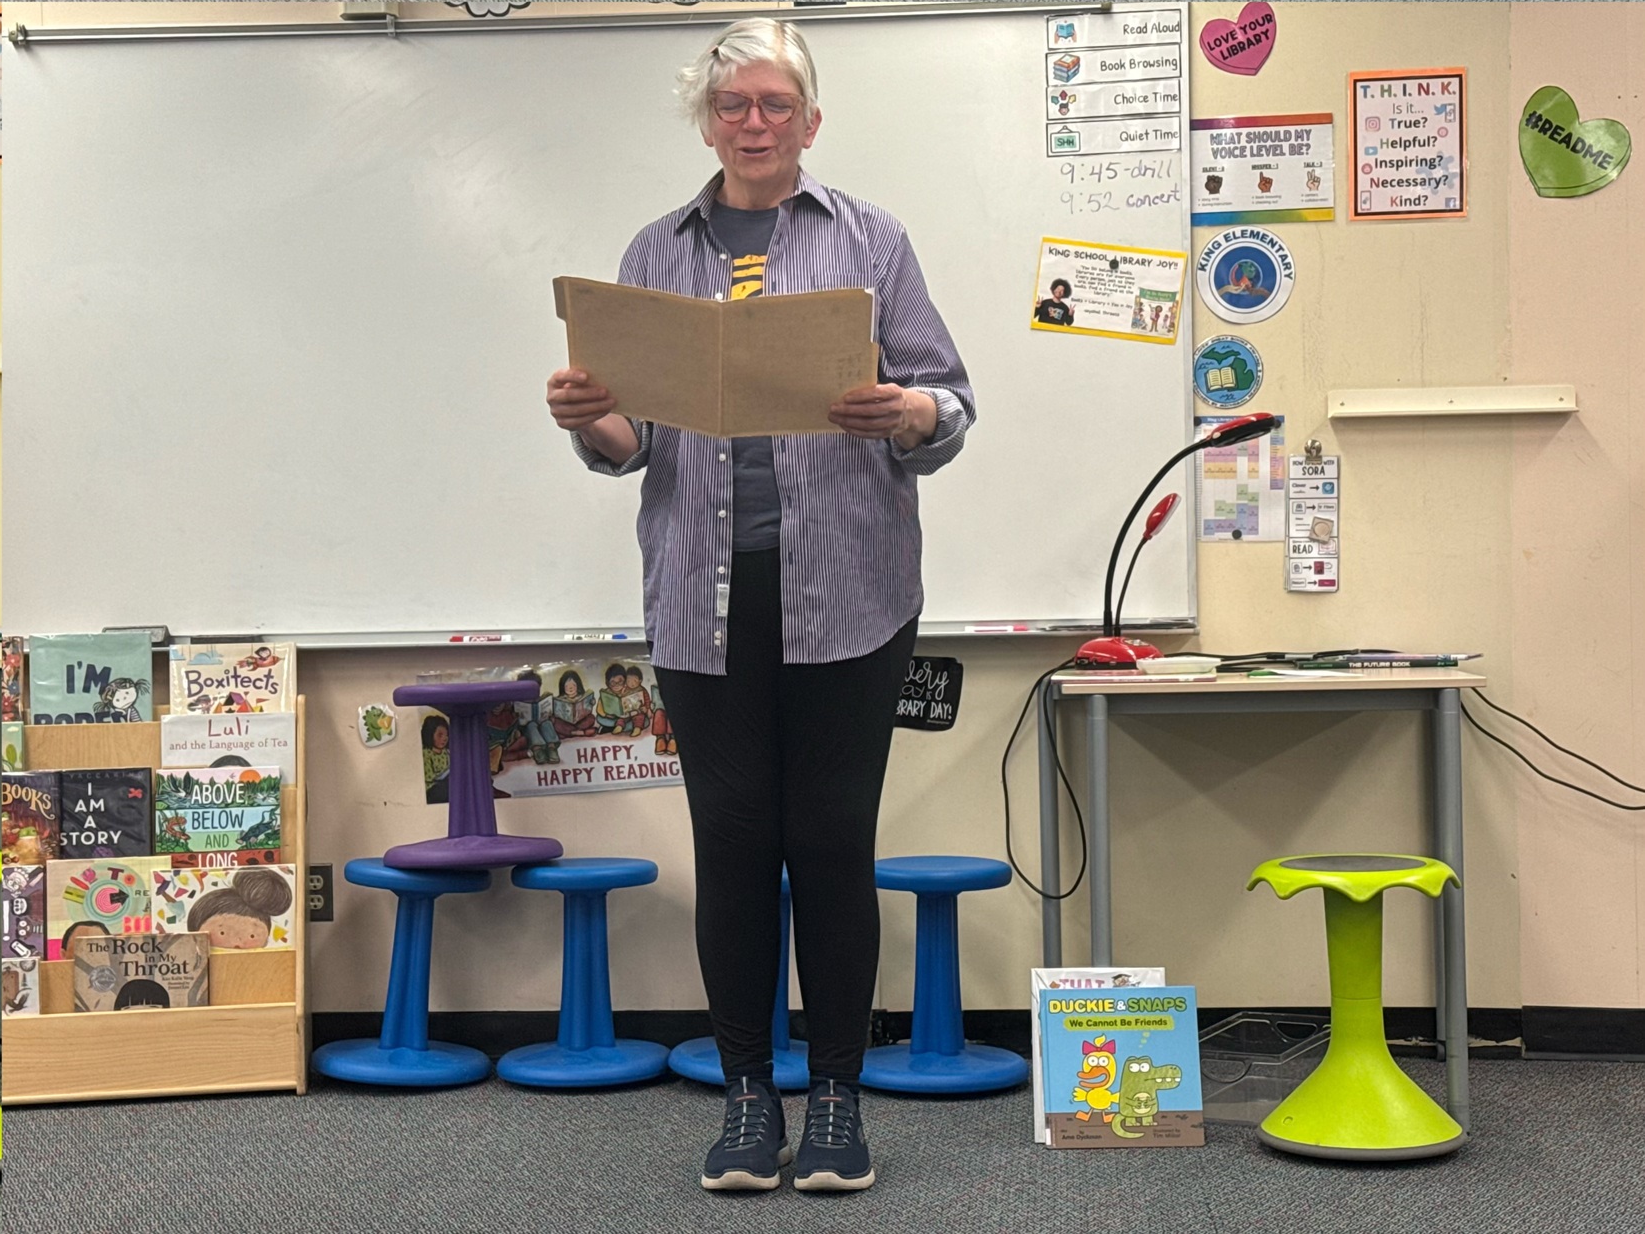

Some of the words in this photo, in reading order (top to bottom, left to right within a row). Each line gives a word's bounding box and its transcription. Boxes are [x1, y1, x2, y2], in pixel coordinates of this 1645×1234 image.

[1123, 23, 1148, 35] Read
[1151, 21, 1180, 33] Aloud
[1207, 29, 1238, 52] LOVE
[1239, 13, 1274, 36] YOUR
[1220, 28, 1271, 61] LIBRARY
[1100, 60, 1125, 72] Book
[1129, 56, 1177, 70] Browsing
[1114, 94, 1149, 105] Choice
[1152, 91, 1178, 102] Time
[1389, 116, 1428, 129] True?
[1057, 137, 1075, 147] SHH
[1119, 131, 1150, 142] Quiet
[1153, 129, 1179, 140] Time
[1245, 129, 1292, 144] SHOULD
[1294, 128, 1312, 142] MY
[1380, 135, 1437, 151] Helpful?
[1524, 110, 1614, 171] #README
[1211, 145, 1248, 160] VOICE
[1250, 144, 1286, 158] LEVEL
[1288, 143, 1311, 156] BE?
[1375, 155, 1443, 171] Inspiring?
[1370, 174, 1449, 189] Necessary?
[1125, 182, 1181, 208] concert
[1390, 195, 1428, 207] Kind?
[1048, 246, 1071, 258] KING
[1073, 250, 1109, 262] SCHOOL
[1198, 240, 1222, 272] KING
[1223, 229, 1294, 281] ELEMENTARY
[1302, 466, 1325, 476] SORA
[1292, 544, 1313, 554] READ
[66, 661, 112, 695] I'M
[185, 667, 279, 698] Boxitects
[930, 701, 952, 719] DAY!
[207, 718, 250, 738] Luli
[169, 740, 188, 751] and
[190, 739, 206, 750] the
[209, 739, 255, 752] Language
[258, 737, 269, 748] of
[271, 737, 288, 747] Tea
[576, 744, 638, 764] HAPPY,
[536, 767, 595, 787] HAPPY
[74, 799, 105, 812] AM
[191, 809, 245, 830] BELOW
[59, 830, 122, 846] STORY
[205, 833, 230, 848] AND
[86, 943, 110, 953] The
[112, 938, 163, 955] Rock
[144, 954, 155, 963] in
[158, 954, 176, 965] My
[118, 959, 190, 978] Throat
[1049, 998, 1115, 1014] DUCKIE
[1116, 1000, 1126, 1011] &
[1127, 997, 1187, 1012] SNAPS
[1070, 1019, 1083, 1028] We
[1086, 1018, 1118, 1027] Cannot
[1120, 1018, 1132, 1027] Be
[1135, 1018, 1167, 1027] Friends
